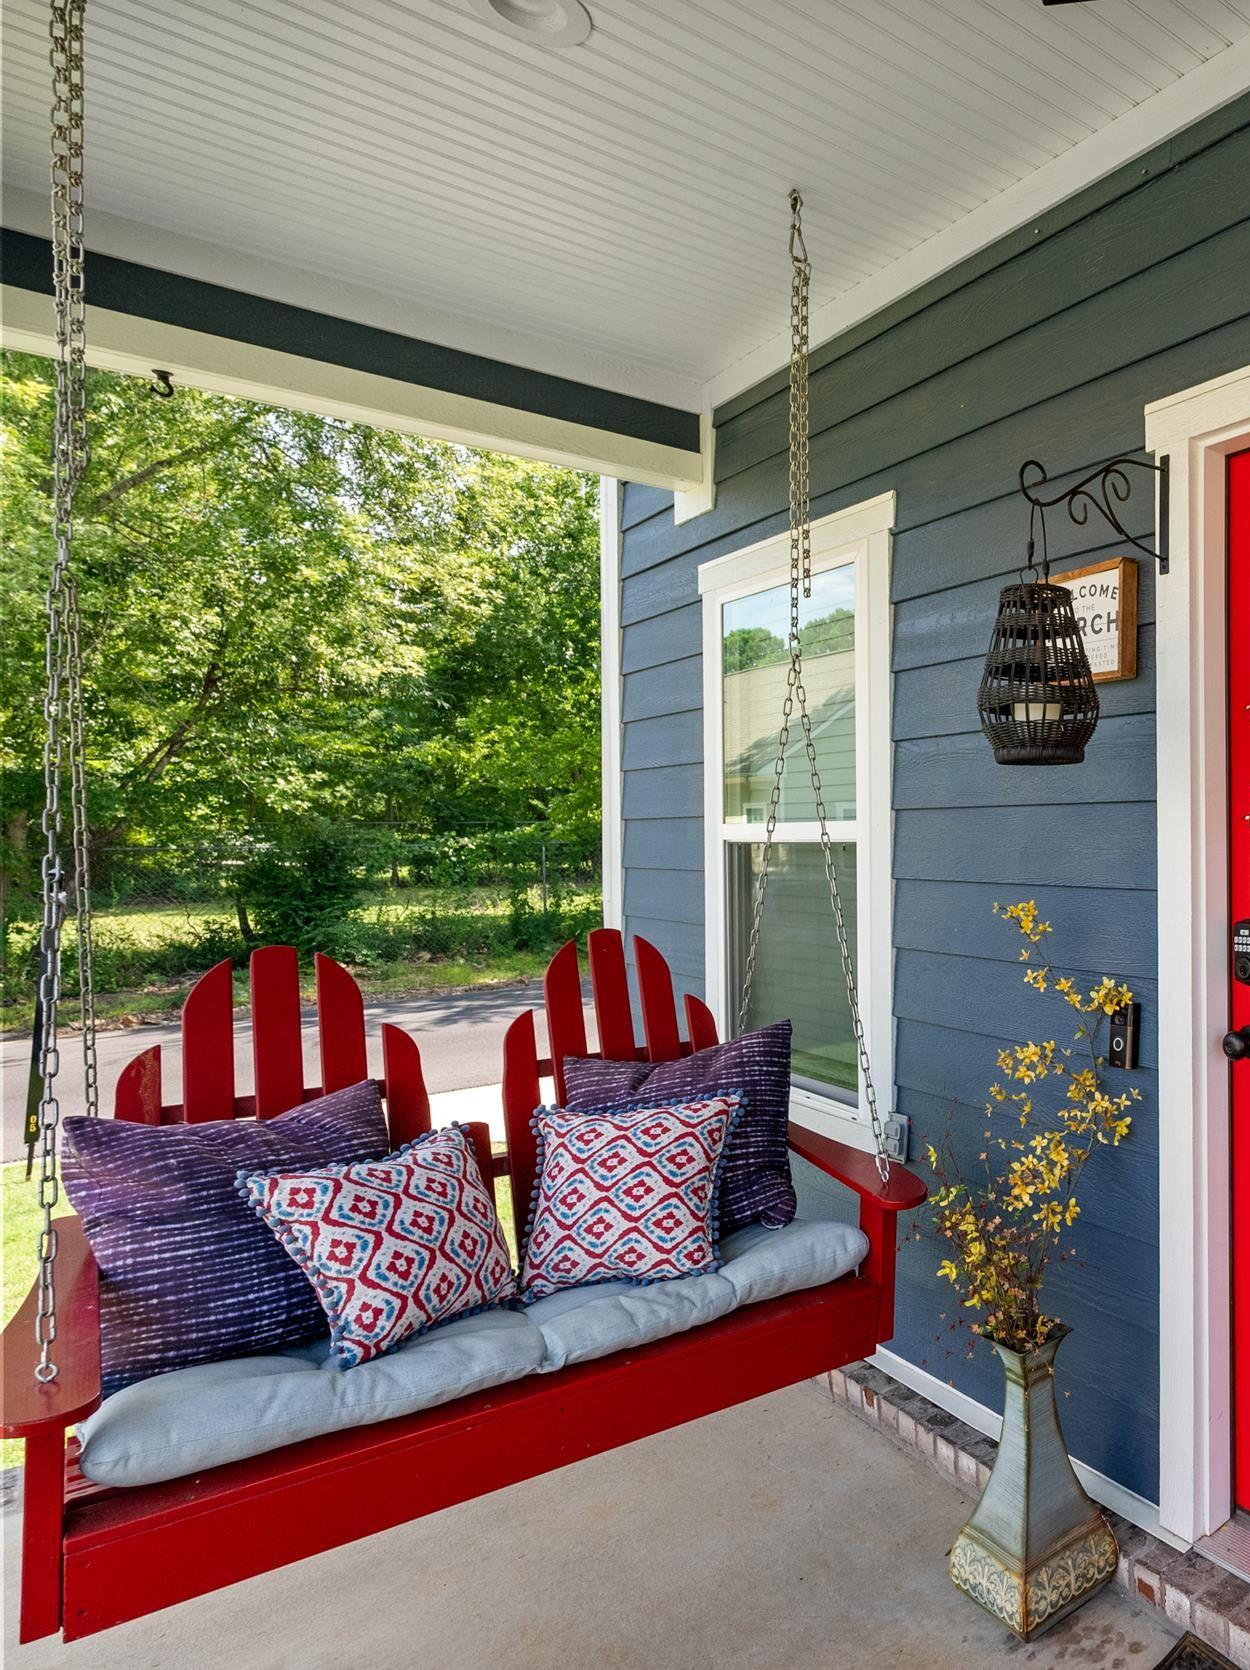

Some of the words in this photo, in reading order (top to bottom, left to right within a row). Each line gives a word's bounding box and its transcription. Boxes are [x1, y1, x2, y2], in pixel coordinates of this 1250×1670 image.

[1071, 584, 1119, 600] LCOME
[1082, 604, 1095, 612] THE
[1077, 610, 1119, 637] RCH
